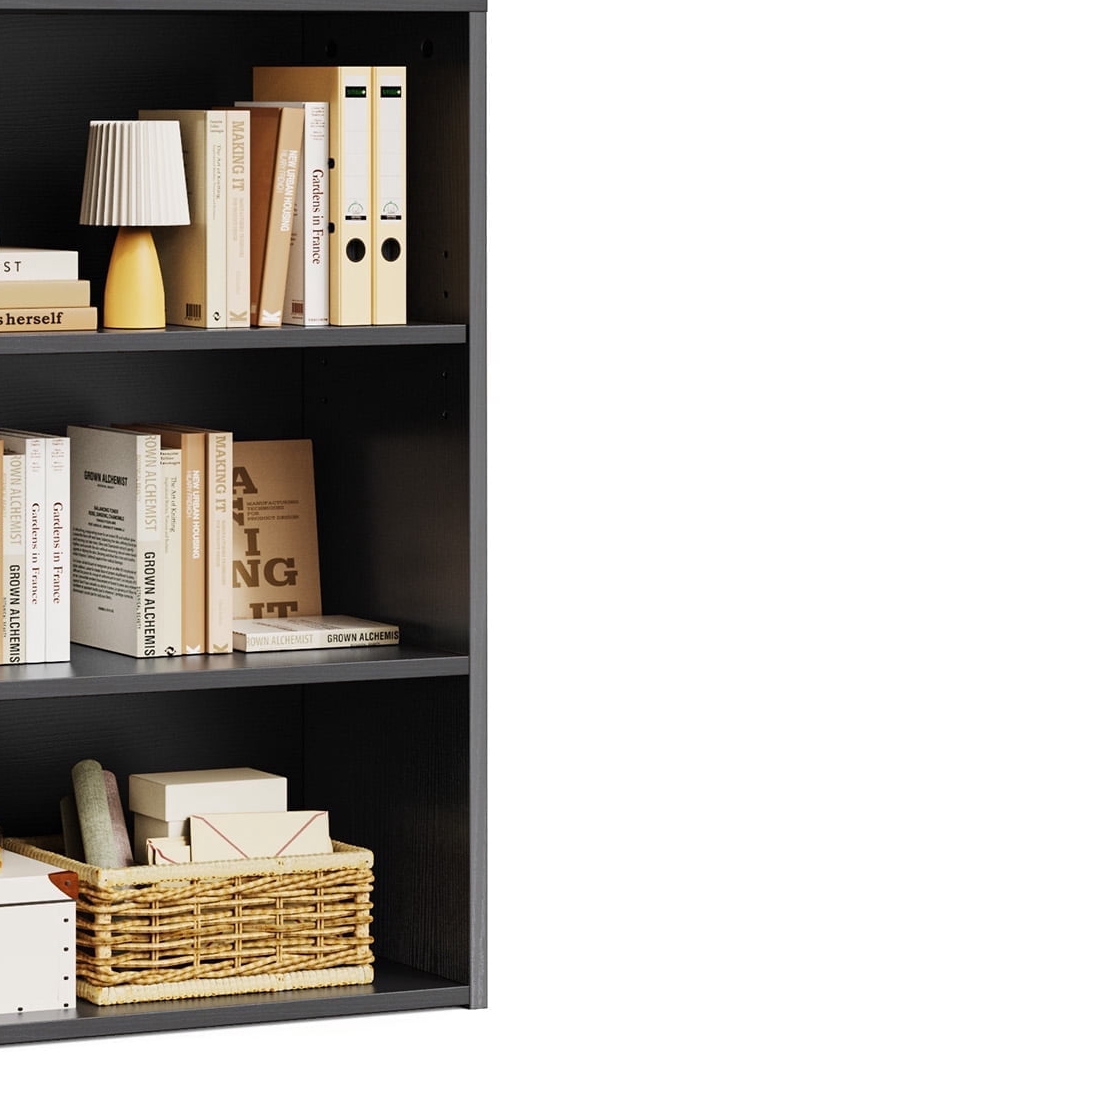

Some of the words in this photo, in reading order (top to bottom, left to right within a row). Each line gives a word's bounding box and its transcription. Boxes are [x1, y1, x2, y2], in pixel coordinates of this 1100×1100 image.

[232, 121, 245, 173] MAKING
[287, 150, 299, 168] NEW
[232, 178, 245, 191] IT
[283, 168, 296, 196] URBAN
[311, 169, 324, 213] Gardens
[280, 196, 293, 232] HOUSING
[311, 215, 324, 226] in
[311, 229, 324, 265] France
[6, 312, 64, 325] herself
[144, 435, 157, 468] ROWN
[216, 435, 226, 494] MAKING
[10, 454, 22, 484] ROWN
[84, 470, 102, 482] GROWN
[102, 472, 128, 487] ALCHEMIST
[192, 470, 200, 490] NEW
[10, 488, 22, 545] ALCHEMIST
[144, 471, 157, 531] ALCHEMIST
[192, 491, 200, 520] URBAN
[216, 498, 226, 513] IT
[31, 502, 40, 549] Gardens
[52, 501, 64, 549] Gardens
[169, 508, 177, 533] Knitting
[52, 551, 64, 562] in
[192, 521, 200, 559] HOUSING
[31, 552, 40, 563] in
[144, 551, 156, 594] GROWN
[9, 564, 21, 600] GROWN
[31, 567, 40, 605] France
[52, 566, 64, 604] France
[9, 609, 21, 664] ALCHEMIS
[144, 598, 156, 656] ALCHEMIS
[246, 636, 269, 646] ROWN
[271, 634, 313, 645] ALCHEMIST
[327, 633, 357, 643] GROWN
[359, 630, 398, 641] ALCHEMIS
